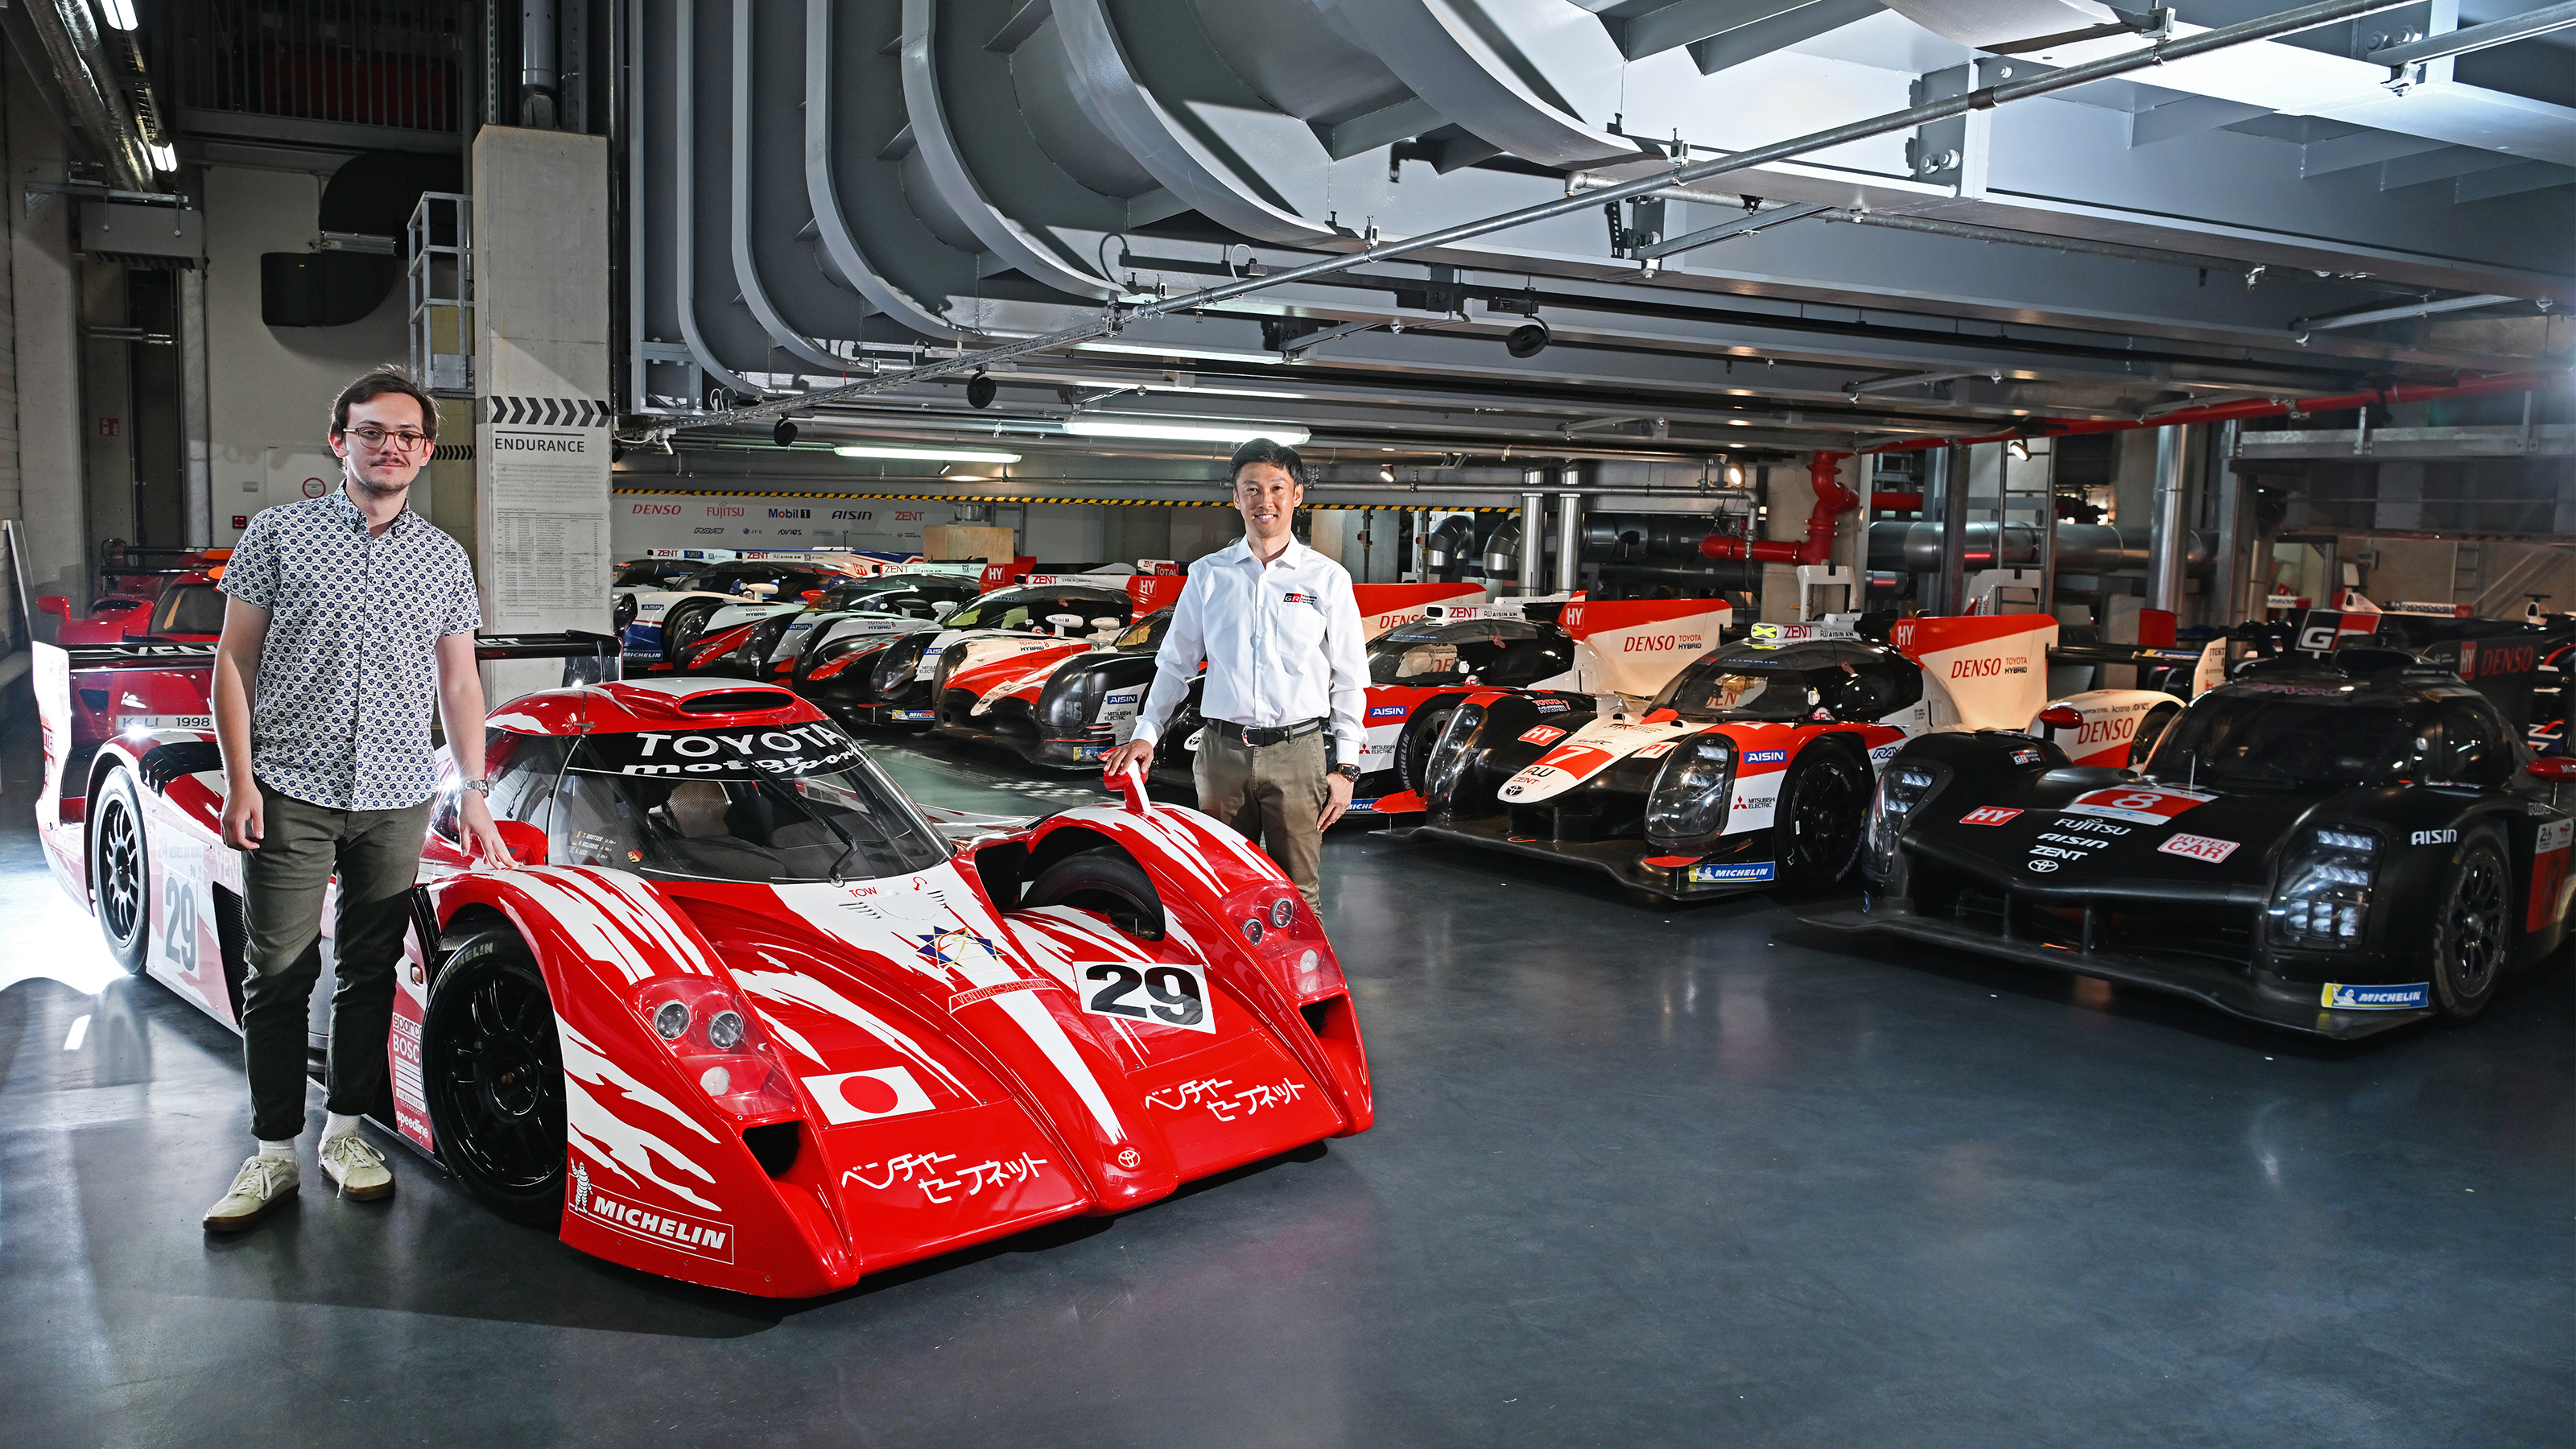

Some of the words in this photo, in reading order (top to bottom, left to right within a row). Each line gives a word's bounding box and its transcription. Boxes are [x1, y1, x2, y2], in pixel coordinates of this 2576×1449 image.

[495, 438, 585, 452] ENDURANCE
[632, 504, 682, 515] DENSO
[707, 502, 745, 519] FUJITSU
[768, 509, 799, 518] Mobil
[800, 509, 811, 518] 1
[832, 510, 873, 521] AISIN
[895, 511, 925, 521] ZENT
[886, 565, 909, 573] ZENT
[989, 567, 1003, 580] HY
[1155, 565, 1179, 576] TOTAL
[1032, 575, 1059, 584] ZENT
[1139, 579, 1156, 593] HY
[1449, 607, 1479, 618] ZENT
[1567, 607, 1583, 625] HY
[1783, 625, 1812, 639] ZENT
[1897, 625, 1914, 646] HY
[1624, 635, 1675, 653] DENSO
[1951, 658, 2001, 679] DENSO
[2005, 657, 2029, 666] TOYOTA
[2460, 649, 2475, 673] HY
[2480, 646, 2534, 677] DENSO
[2004, 665, 2028, 675] HYBRID
[1109, 696, 1136, 704] AISIN
[1532, 698, 1563, 706] TOYOTA
[1562, 700, 1571, 710] 7
[1373, 707, 1404, 716] AISIN
[1538, 704, 1568, 714] HYBRID
[2112, 704, 2131, 713] Acronis
[122, 716, 159, 728] K-LI
[175, 717, 210, 727] 1998
[1525, 727, 1560, 741] HY
[2077, 717, 2134, 745] DENSO
[636, 723, 847, 757] TOYOTA
[1545, 745, 1594, 765] 7
[1639, 744, 1671, 755] P1
[1748, 752, 1785, 762] AISIN
[621, 756, 806, 774] motor
[1398, 733, 1413, 790] MICHELIN
[2014, 755, 2029, 763] GR
[1513, 776, 1540, 785] ZENT
[2112, 793, 2163, 809] 8
[1971, 808, 2017, 823] HY
[2054, 818, 2132, 836] FUJITSU
[2037, 833, 2109, 848] AISIN
[2176, 834, 2233, 851] HYPER
[2411, 829, 2458, 846] AISIN
[2029, 845, 2088, 861] ZENT
[2167, 842, 2223, 861] CAR
[1715, 867, 1769, 877] MICHELIN
[848, 886, 878, 898] TOW
[165, 876, 196, 972] 29
[440, 942, 494, 991] MICHELIN
[956, 985, 998, 1005] VENTURE
[1086, 964, 1204, 1026] 29
[2358, 991, 2421, 1003] MICHELIN
[1145, 1076, 1233, 1111] ベンチャー
[1207, 1077, 1306, 1122] セーフネット
[400, 1100, 423, 1117] TECHNOLOGY
[396, 1110, 429, 1138] speedline
[841, 1151, 957, 1190] ベンチャー
[917, 1151, 1047, 1203] セーフネット
[593, 1195, 726, 1249] MICHELIN
